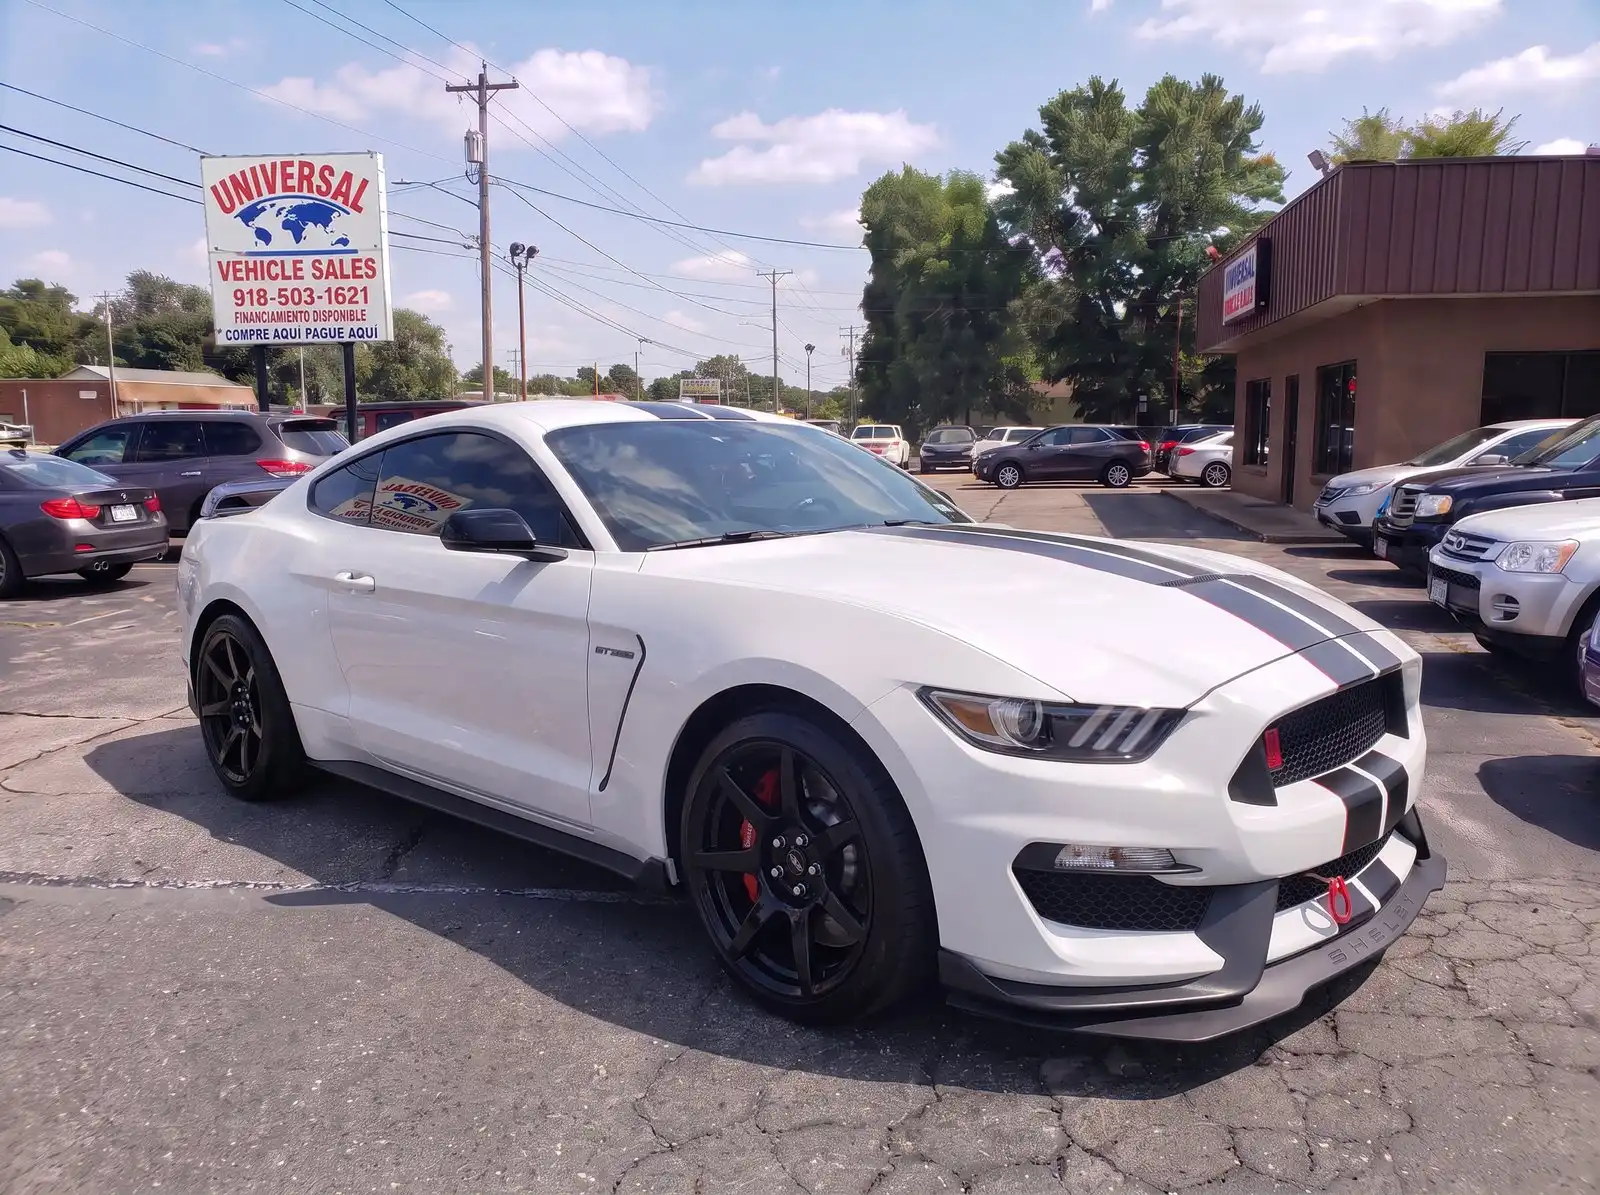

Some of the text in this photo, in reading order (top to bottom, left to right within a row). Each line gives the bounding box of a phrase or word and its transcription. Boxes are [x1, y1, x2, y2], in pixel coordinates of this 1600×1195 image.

[210, 161, 369, 214] UNIVERSAL
[217, 257, 377, 281] VEHICLE SALES
[233, 286, 368, 307] 918-503-1621
[234, 309, 367, 324] FINANCIAMIENTO DISPONIBLE
[225, 328, 270, 341] COMPRE
[305, 327, 345, 339] PAGUE
[1328, 895, 1415, 965] SHELBY
